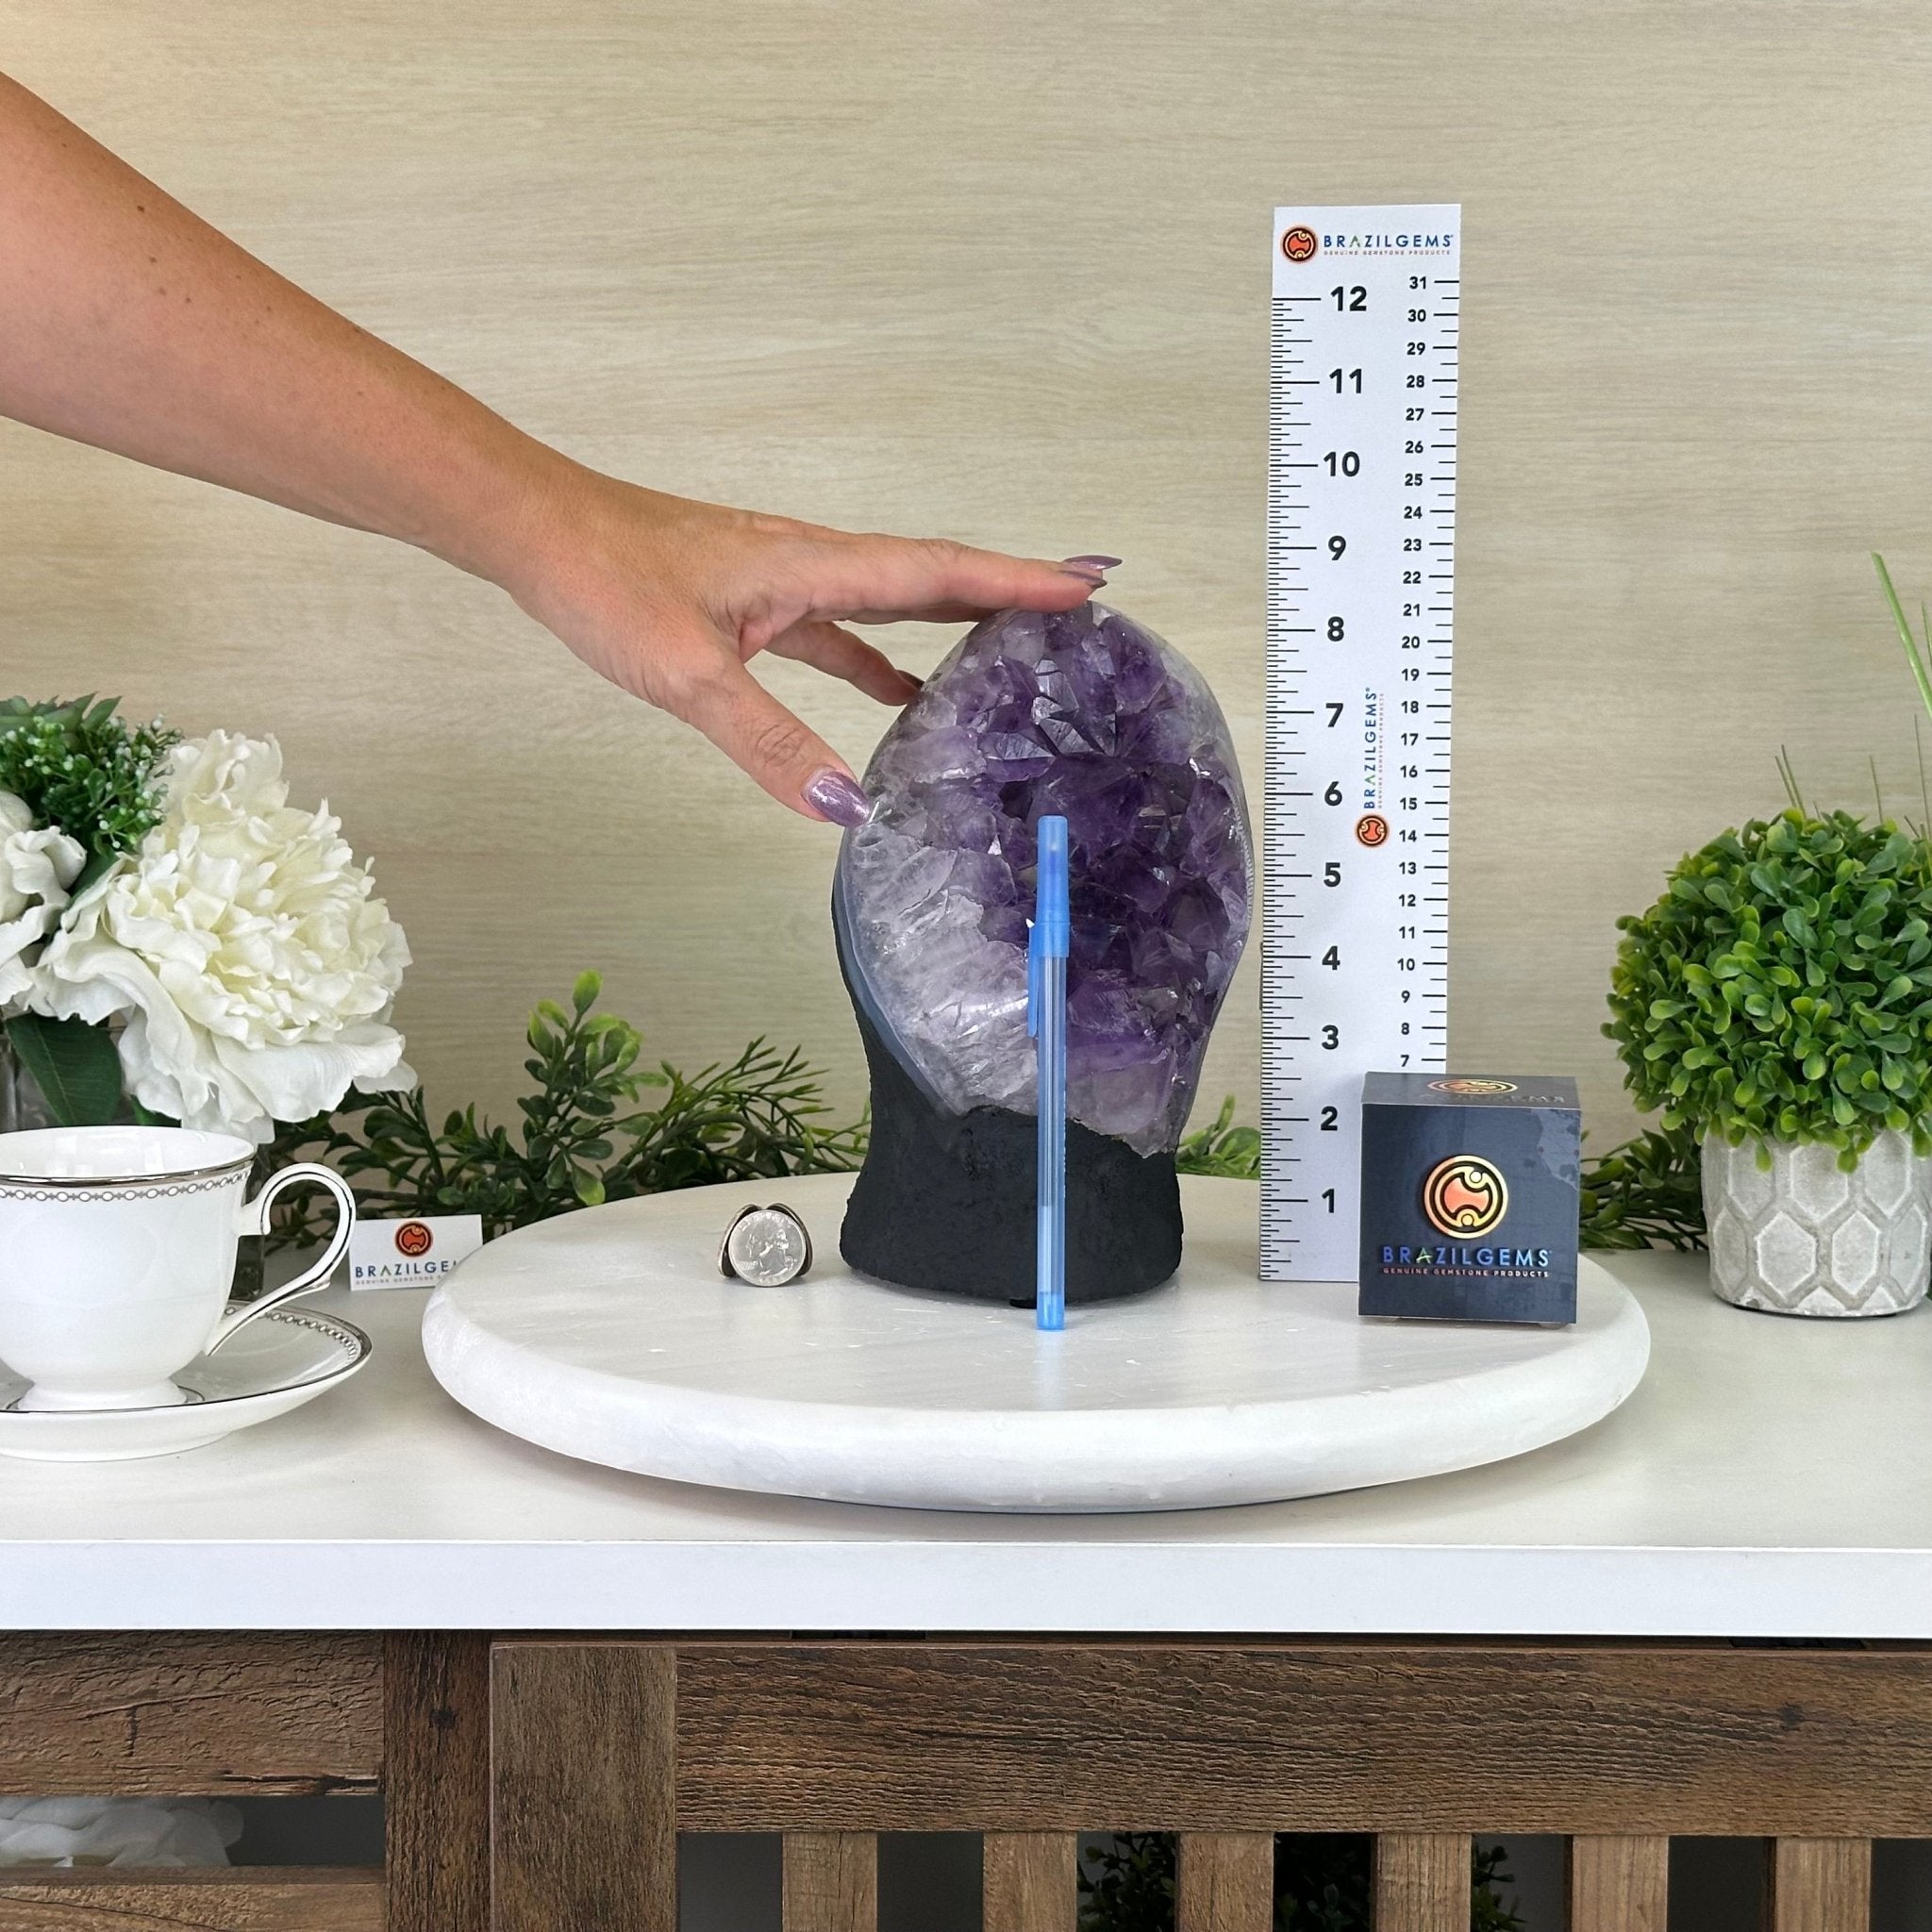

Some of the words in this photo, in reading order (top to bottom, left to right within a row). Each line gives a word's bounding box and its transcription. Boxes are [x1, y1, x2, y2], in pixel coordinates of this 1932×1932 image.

[1408, 275, 1426, 291] 31
[1330, 285, 1368, 312] 12
[1407, 308, 1427, 323] 30
[1407, 341, 1426, 356] 29
[1328, 368, 1362, 394] 11
[1406, 375, 1425, 389] 28
[1405, 407, 1425, 422] 27
[1405, 440, 1424, 454] 26
[1323, 451, 1360, 477] 10
[1404, 473, 1424, 487] 25
[1403, 505, 1424, 520] 24
[1327, 535, 1347, 561] 9
[1403, 538, 1423, 552] 23
[1402, 571, 1422, 585] 22
[1403, 603, 1421, 617] 21
[1326, 616, 1345, 642] 8
[1401, 635, 1421, 649] 20
[1401, 668, 1420, 682] 19
[1401, 700, 1420, 714] 18
[1325, 702, 1344, 728] 7
[1400, 732, 1419, 746] 17
[1400, 764, 1419, 778] 16
[1324, 780, 1343, 807] 6
[1399, 797, 1418, 810] 15
[1398, 829, 1418, 842] 14
[1323, 861, 1341, 888] 5
[1398, 861, 1417, 875] 13
[1398, 893, 1417, 908] 12
[1398, 925, 1415, 940] 11
[1322, 945, 1341, 971] 4
[1397, 958, 1416, 972] 10
[1401, 990, 1411, 1004] 9
[1401, 1022, 1410, 1036] 8
[1321, 1024, 1340, 1051] 3
[1400, 1054, 1410, 1068] 7
[1320, 1105, 1339, 1132] 2
[1321, 1188, 1335, 1214] 1
[1383, 1246, 1550, 1268] BRAZILGEMS
[355, 1260, 457, 1278] BRAZILGE
